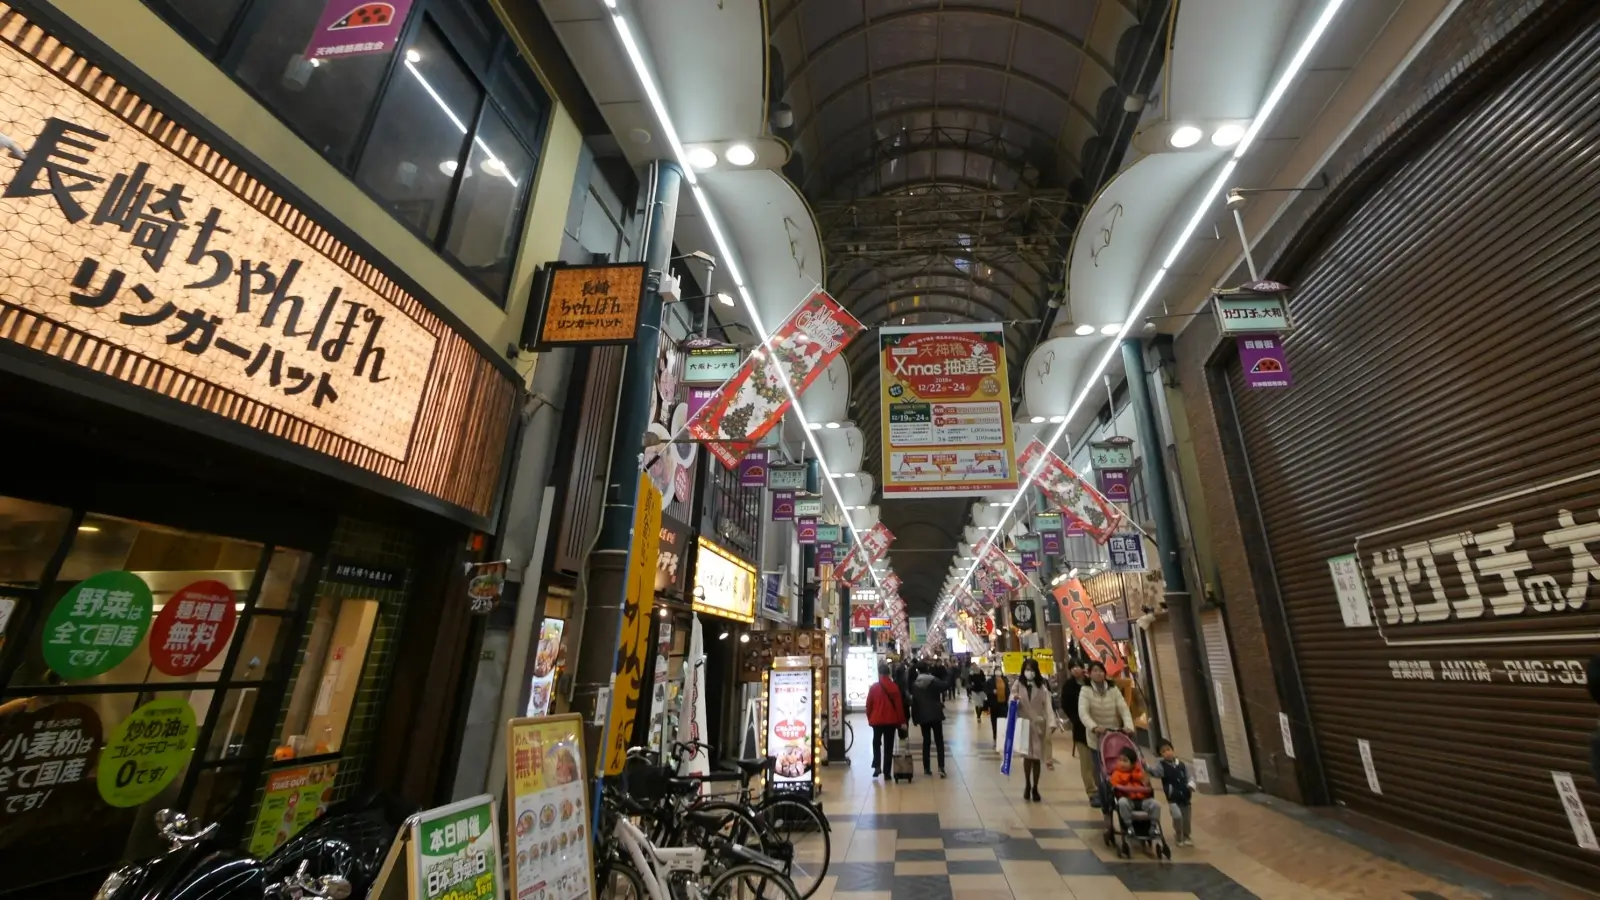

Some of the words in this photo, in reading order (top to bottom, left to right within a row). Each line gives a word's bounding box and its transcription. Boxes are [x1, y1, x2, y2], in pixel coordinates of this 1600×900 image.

[3, 116, 390, 383] 長崎ちゃんぽん
[581, 279, 610, 297] 長崎
[561, 296, 623, 316] ちゃんぽん
[70, 257, 338, 408] リンガーハット
[557, 318, 624, 329] リンガーハット
[919, 342, 967, 357] 天神橋
[689, 362, 736, 371] 大阪トンテキ
[893, 357, 942, 375] Xmas
[944, 357, 996, 375] 抽選会
[1112, 538, 1137, 550] 広告
[69, 587, 144, 620] 野菜は
[49, 621, 139, 647] 全て国産
[163, 622, 219, 651] 無料
[124, 717, 189, 742] 炒め油は
[2, 729, 94, 762] 小麦粉は
[111, 738, 188, 759] コレステロール
[0, 758, 87, 791] 全て国産
[430, 814, 481, 852] 本日開催
